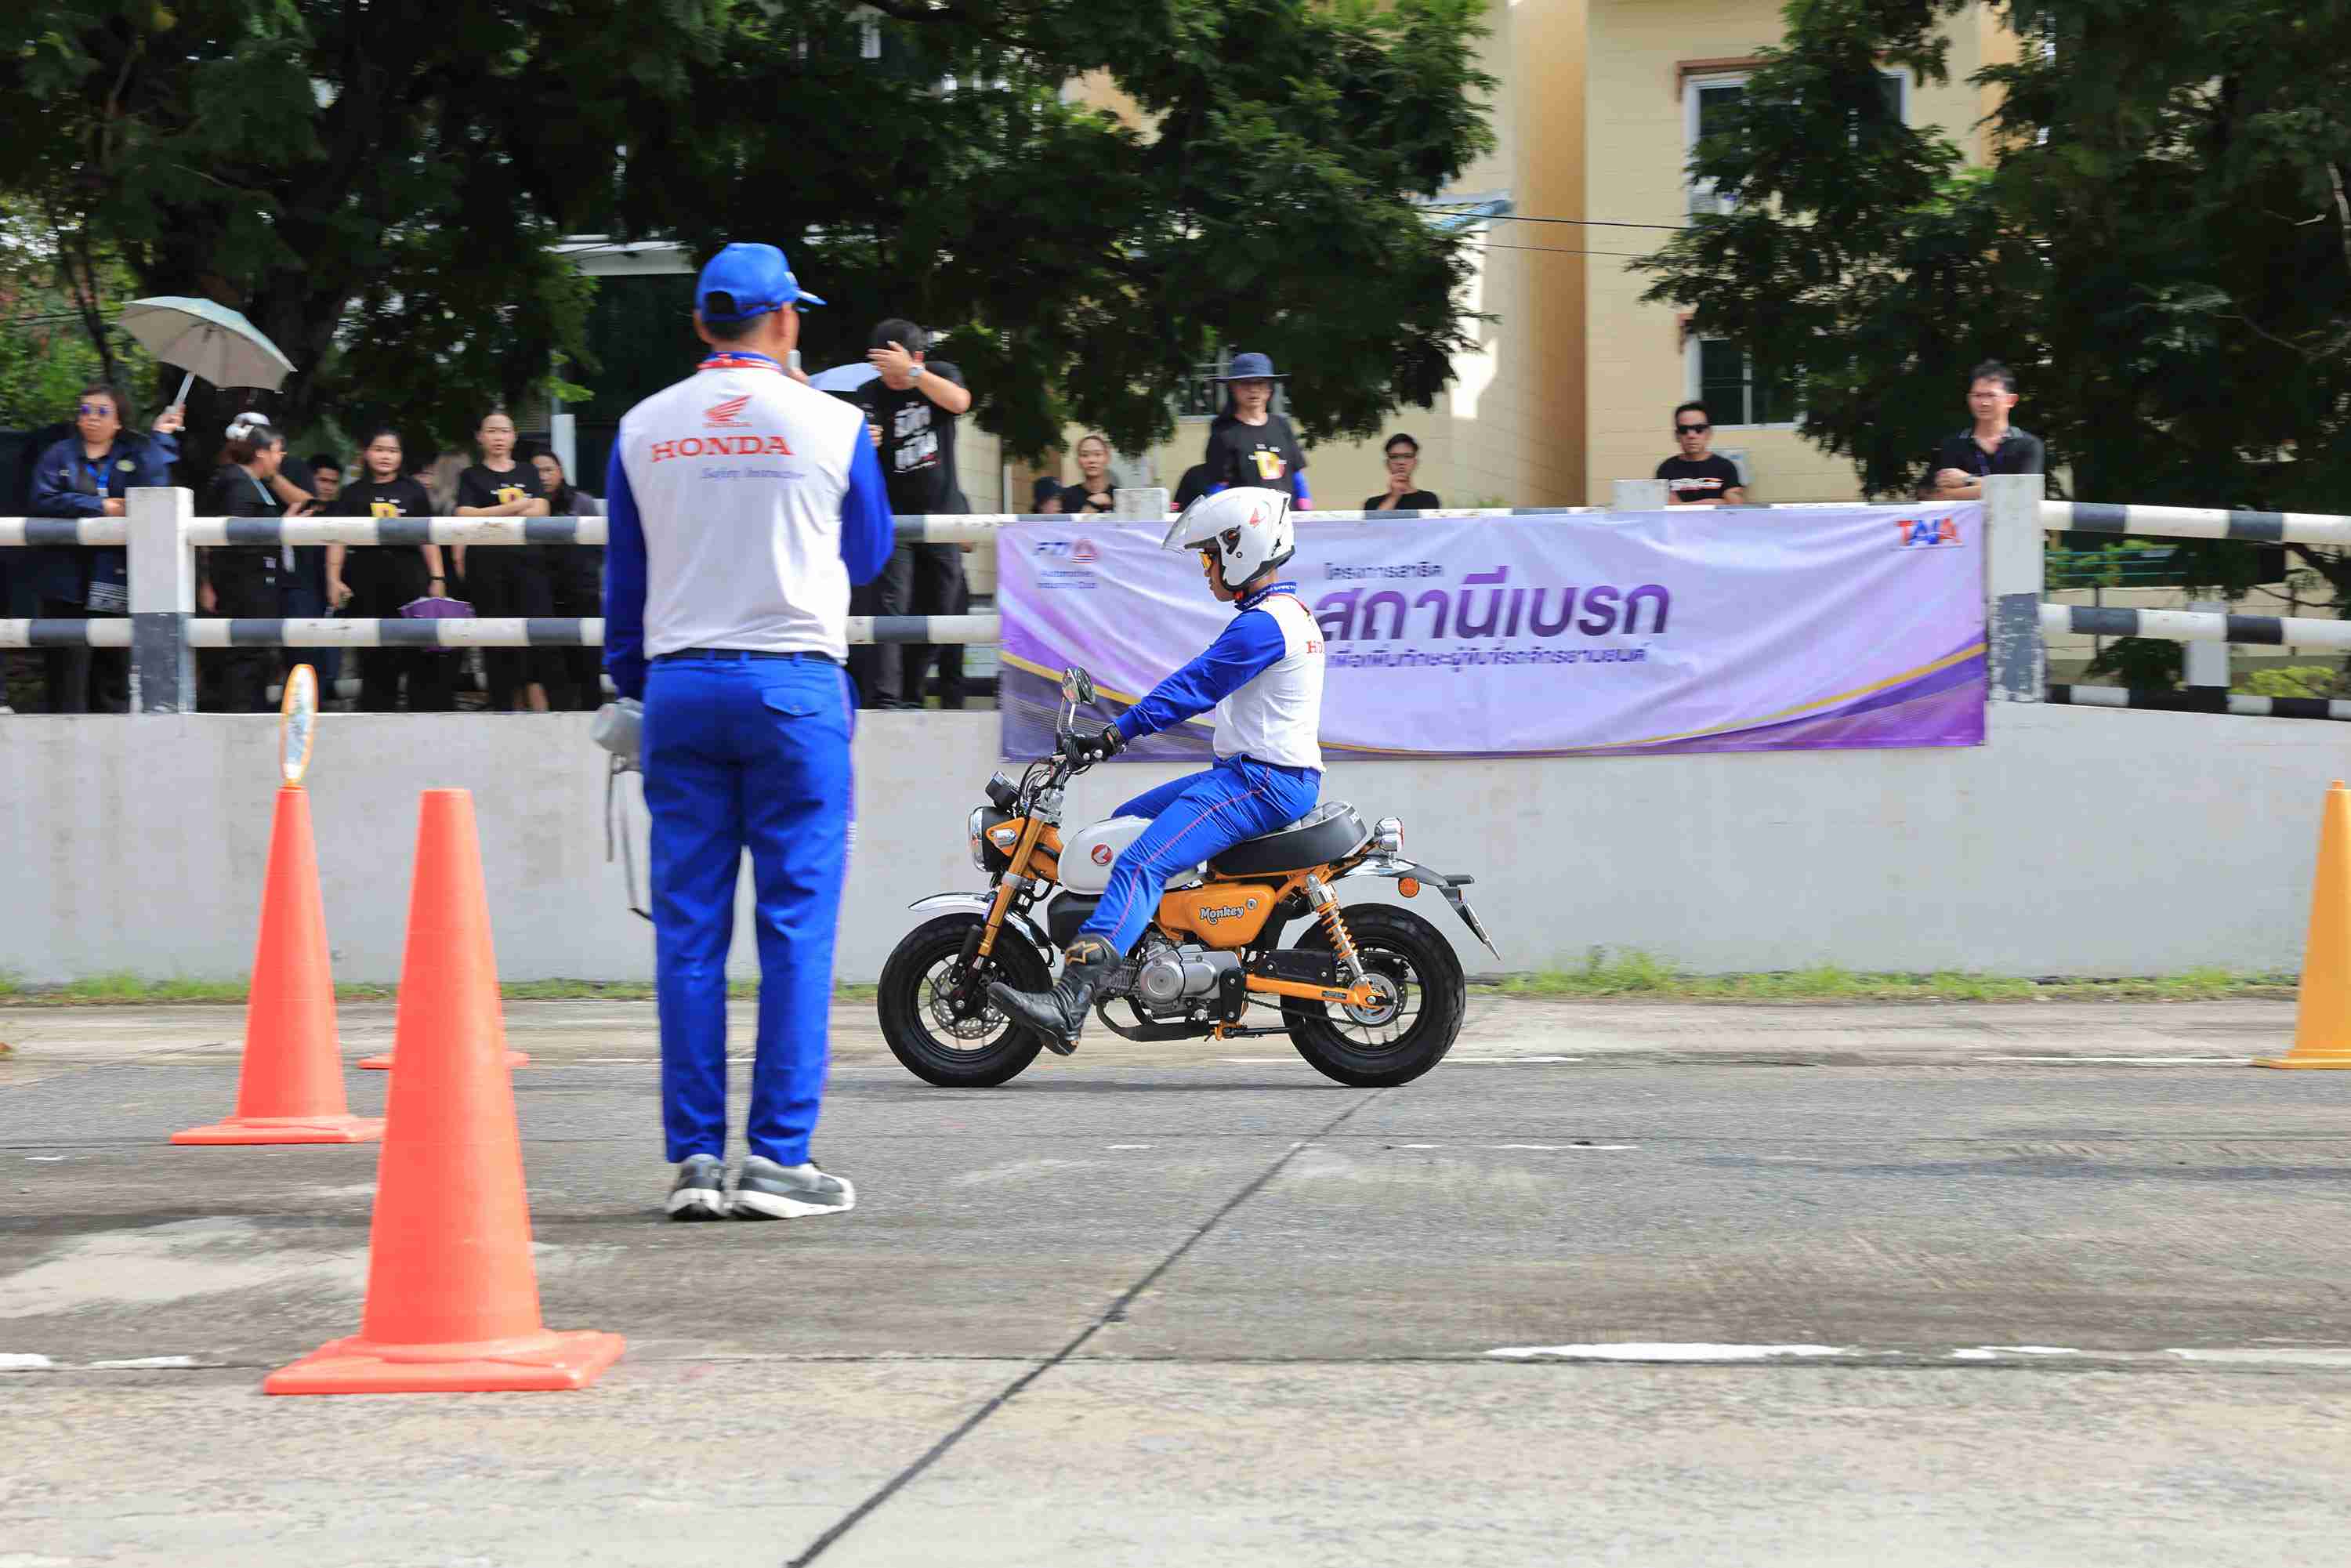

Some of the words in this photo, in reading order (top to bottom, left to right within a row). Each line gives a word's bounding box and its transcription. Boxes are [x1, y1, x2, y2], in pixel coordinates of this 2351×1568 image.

[650, 436, 795, 463] HONDA
[1313, 565, 1670, 642] สถานีเบรก
[1199, 905, 1244, 925] Monkey
